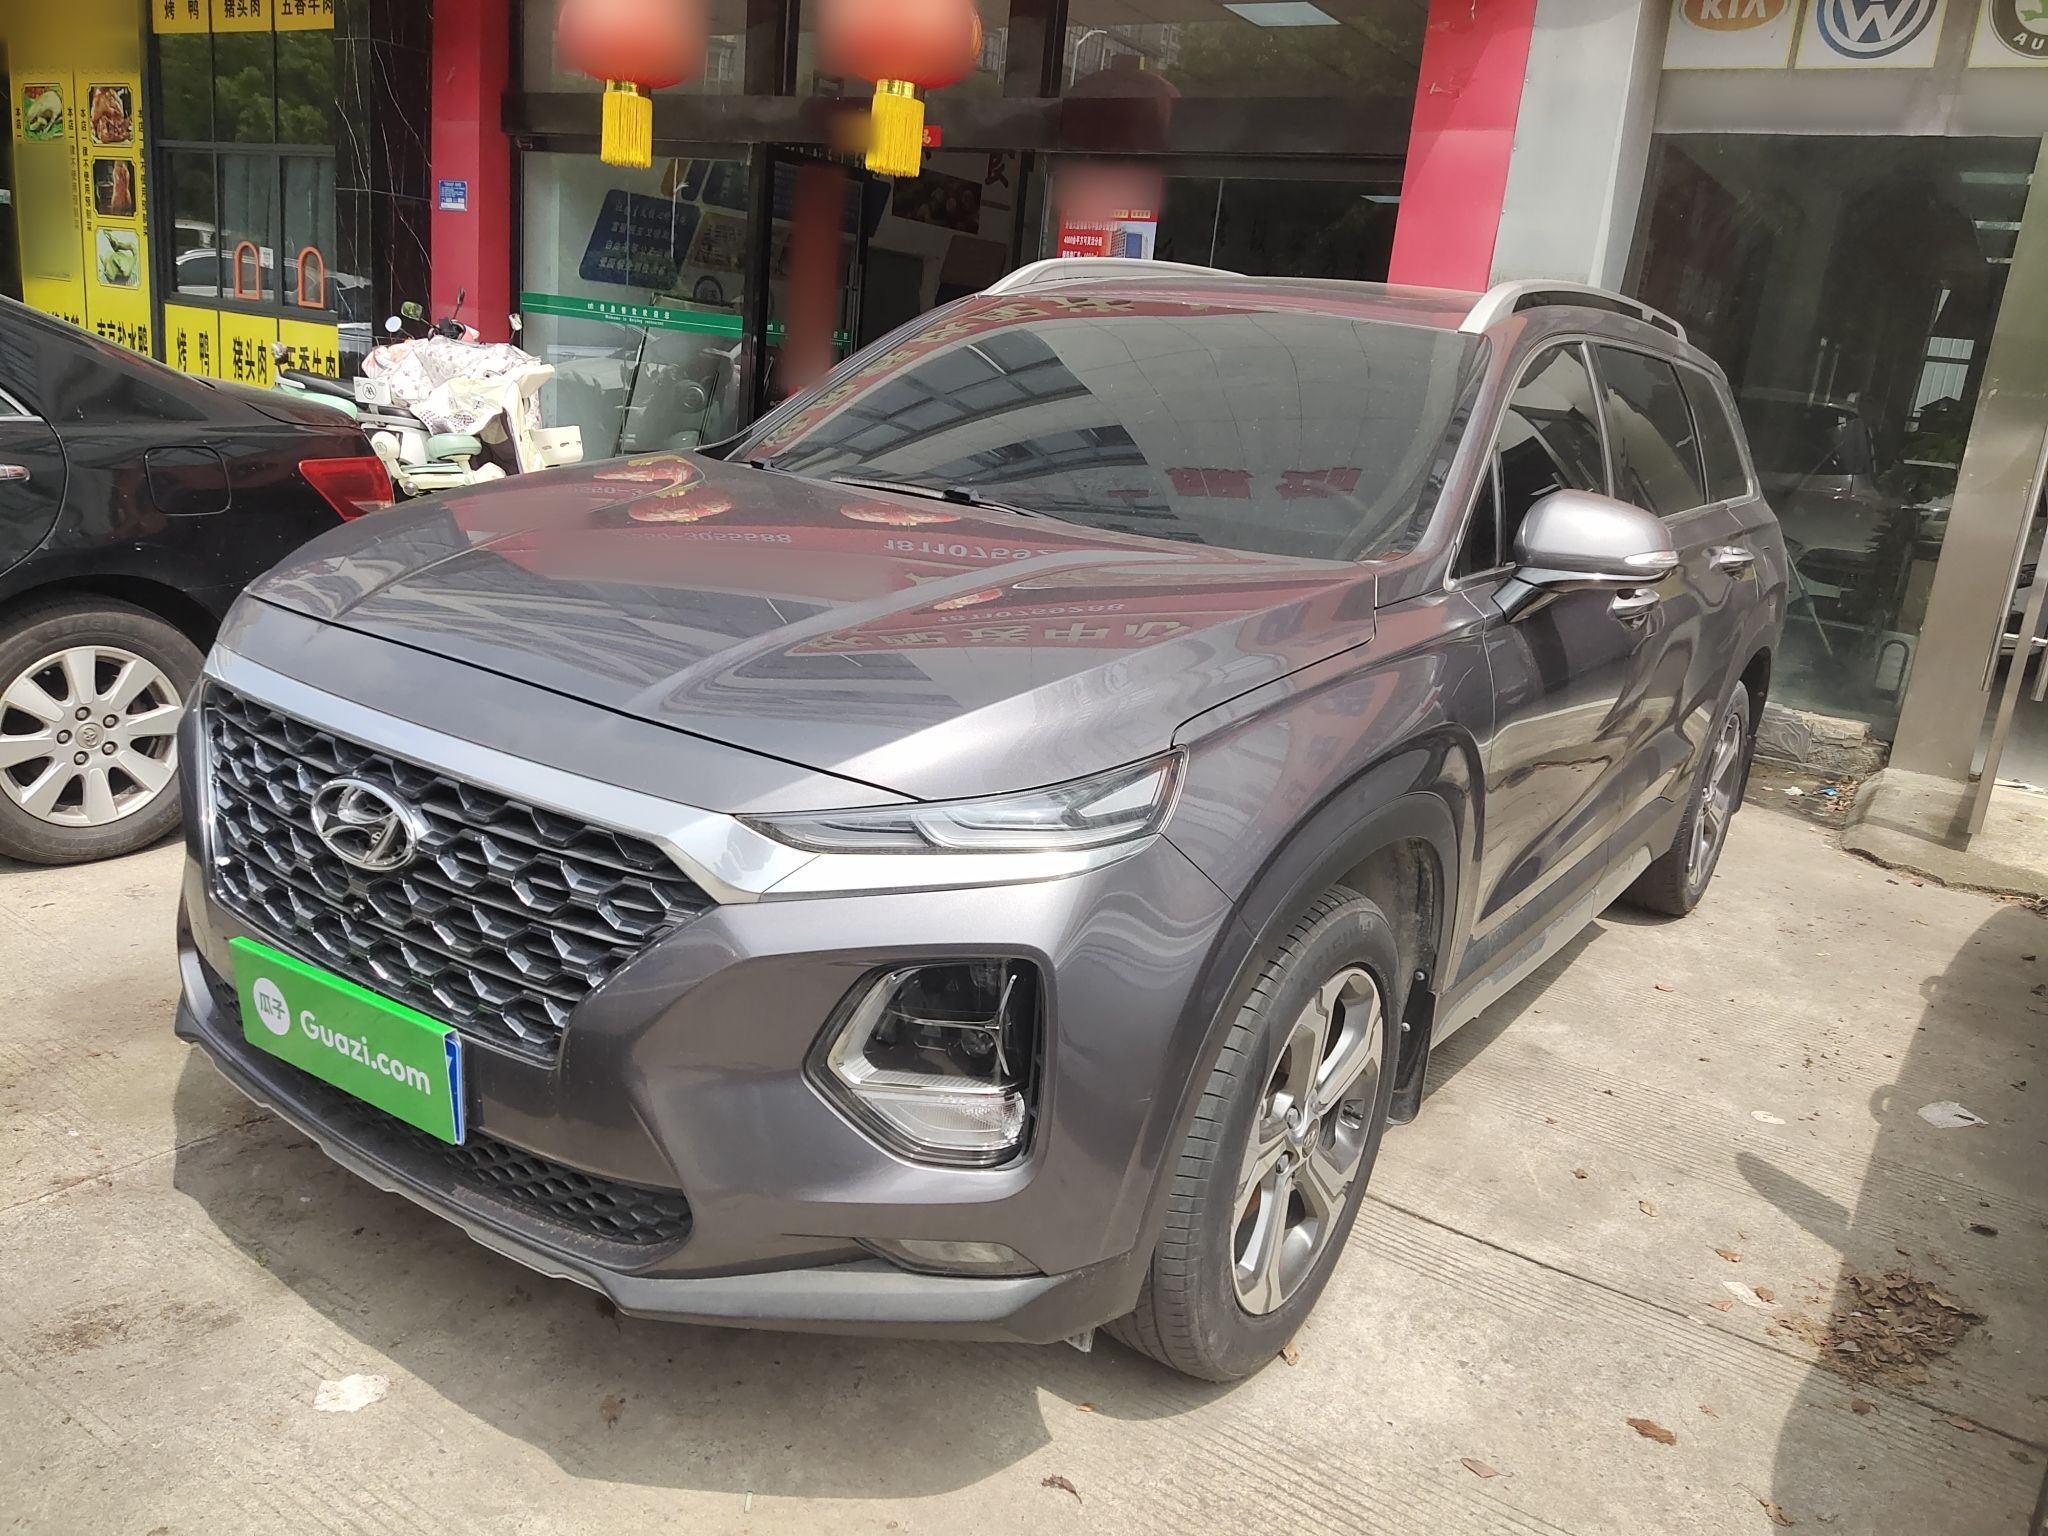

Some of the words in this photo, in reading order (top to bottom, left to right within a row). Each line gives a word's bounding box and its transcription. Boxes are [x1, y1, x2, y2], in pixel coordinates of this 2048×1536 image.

[233, 335, 268, 385] 猪头肉
[258, 991, 287, 1020] 瓜子
[299, 1010, 432, 1096] Guazi.com
